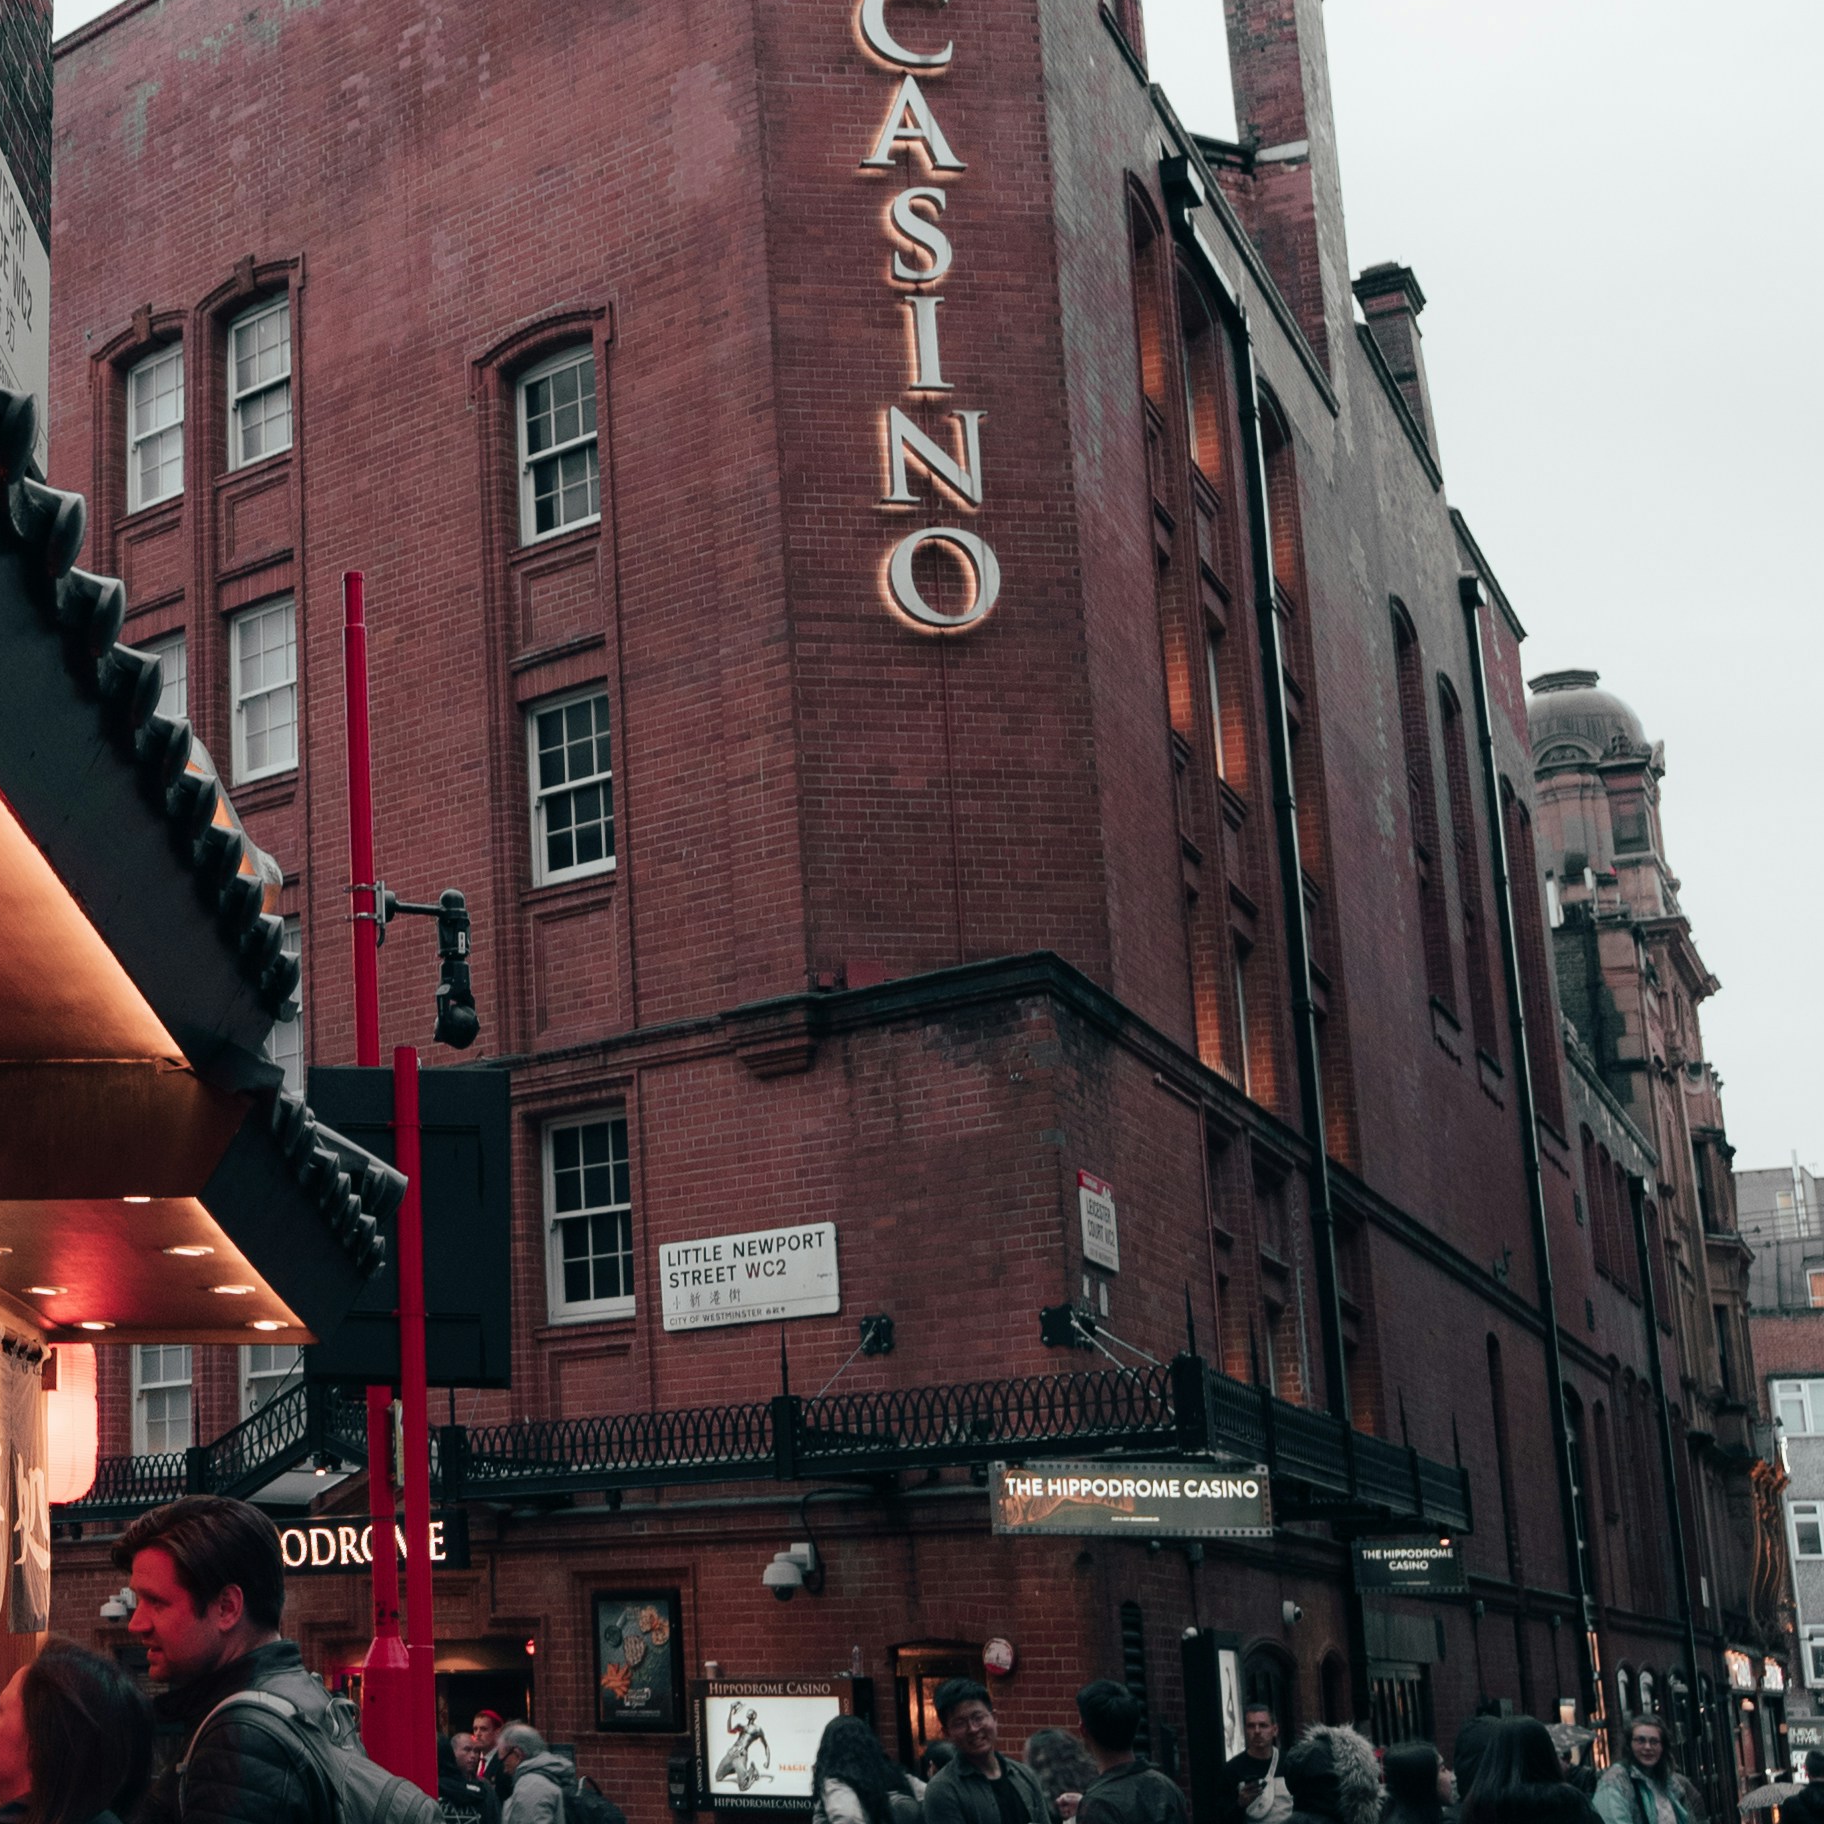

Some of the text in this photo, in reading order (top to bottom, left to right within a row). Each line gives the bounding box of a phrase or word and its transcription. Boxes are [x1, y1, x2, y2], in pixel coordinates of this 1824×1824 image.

[12, 253, 32, 334] WC2
[667, 1231, 825, 1267] LITTLE NEWPORT
[669, 1259, 786, 1289] STREET WC2
[669, 1315, 687, 1326] CITY
[689, 1313, 700, 1324] OF
[702, 1308, 763, 1322] WESTMINSTER
[1005, 1478, 1259, 1499] THE HIPPODROME CASINO
[1362, 1548, 1454, 1560] THE HIPPODROME
[1388, 1560, 1429, 1571] CASINO
[709, 1682, 831, 1695] HIPPODROME CASINO
